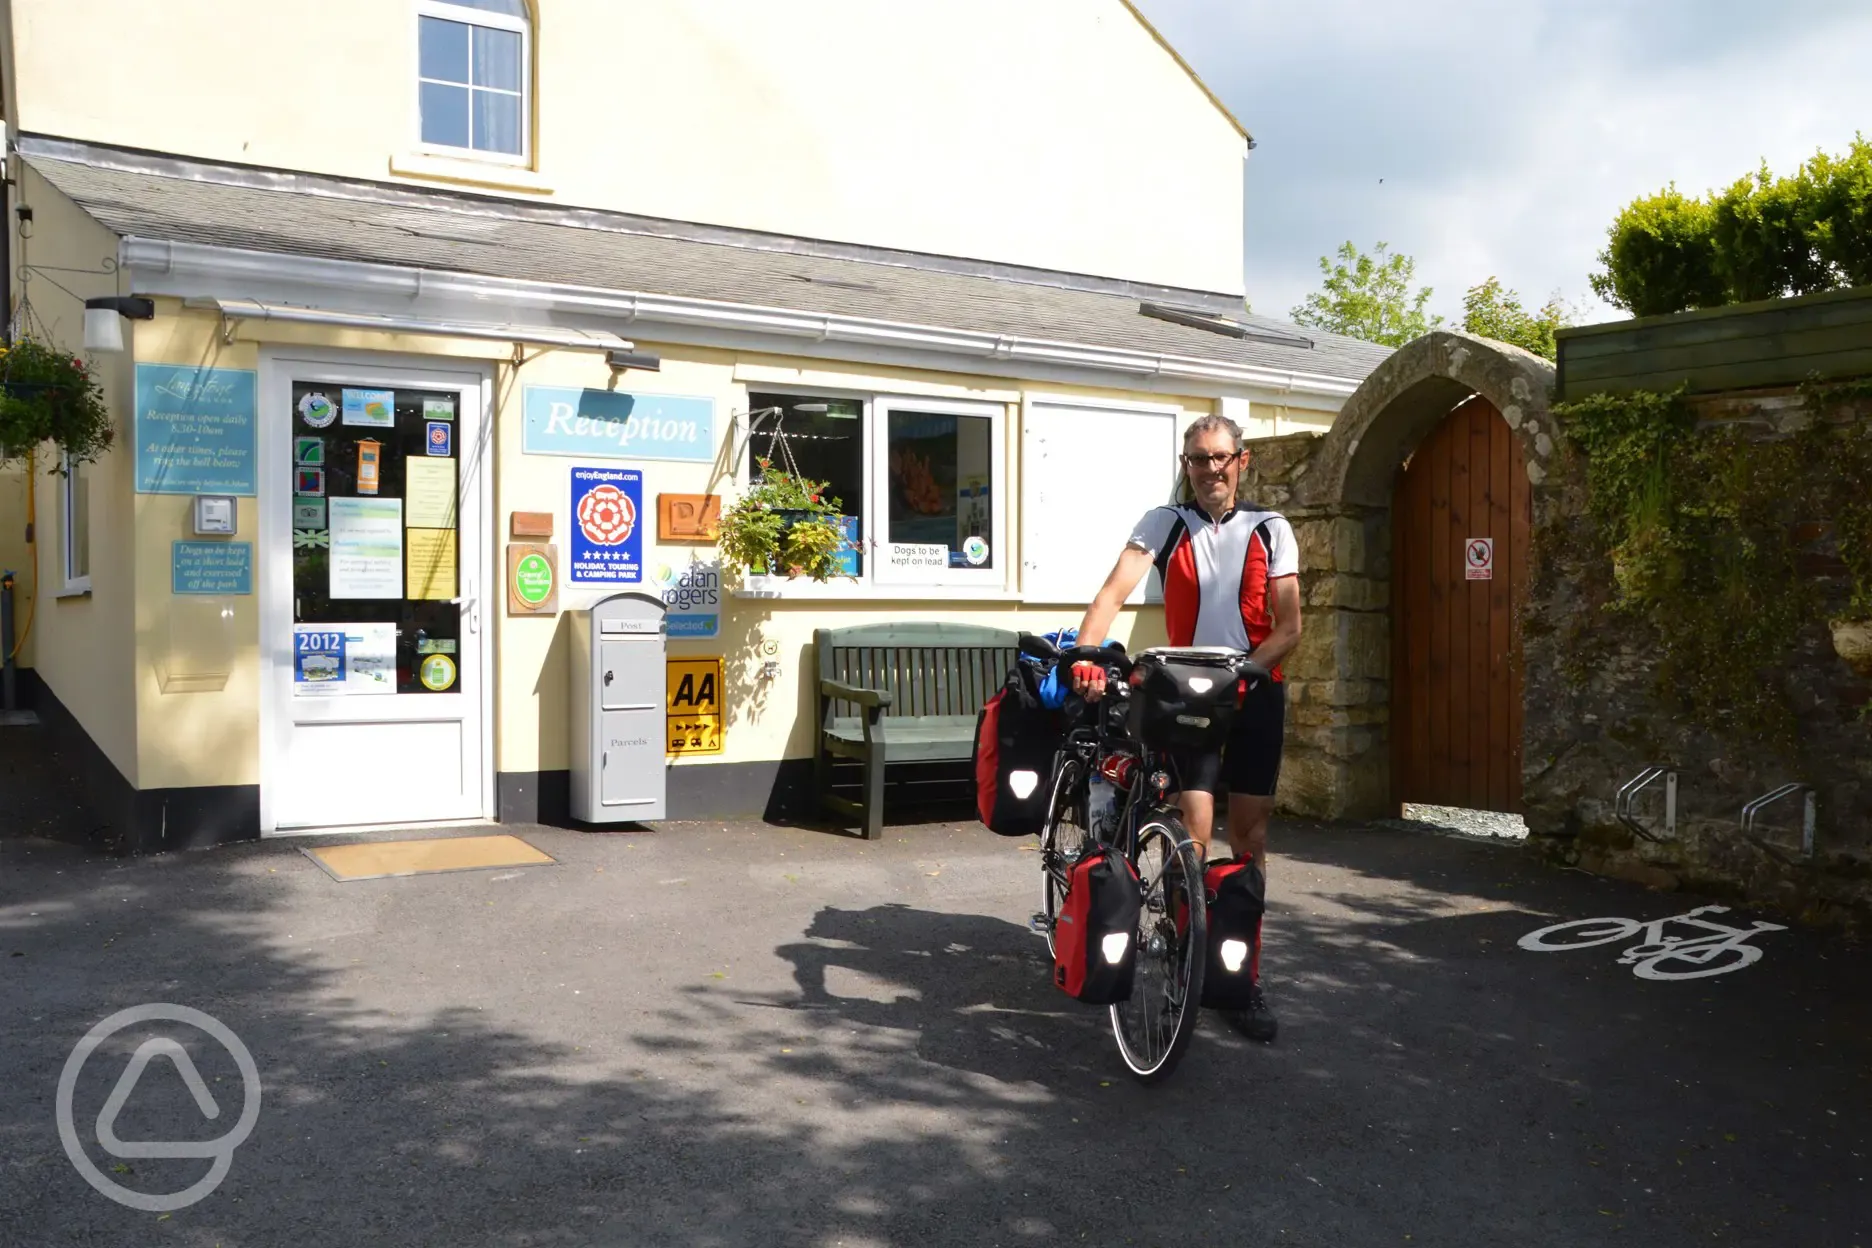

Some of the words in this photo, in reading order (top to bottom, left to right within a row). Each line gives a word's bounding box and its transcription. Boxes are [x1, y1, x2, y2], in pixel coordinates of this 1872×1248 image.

[146, 409, 195, 422] Reception
[198, 413, 220, 424] open
[223, 414, 248, 425] daily
[543, 401, 697, 446] Reception
[146, 443, 158, 453] At
[161, 444, 185, 454] other
[188, 445, 216, 455] times,
[218, 446, 248, 457] please
[154, 456, 174, 468] ring
[177, 456, 191, 467] the
[193, 456, 211, 467] bell
[213, 458, 241, 469] below
[575, 470, 639, 482] enjoyEngland.com
[180, 544, 203, 556] Dogs
[215, 544, 227, 554] be
[228, 545, 246, 556] kept
[894, 546, 916, 556] Dogs
[929, 547, 940, 555] be
[202, 557, 225, 568] short
[574, 561, 605, 571] HOLIDAY,
[608, 562, 639, 571] TOURING
[891, 557, 909, 566] kept
[184, 569, 202, 577] and
[583, 571, 616, 579] CAMPING
[618, 571, 637, 579] PARK
[679, 566, 717, 588] alan
[188, 580, 201, 589] off
[203, 580, 216, 588] the
[217, 580, 238, 590] park
[662, 588, 718, 611] rogers
[620, 621, 643, 630] Post
[300, 633, 340, 650] 2012
[672, 673, 715, 707] AA
[610, 738, 648, 747] Parcels
